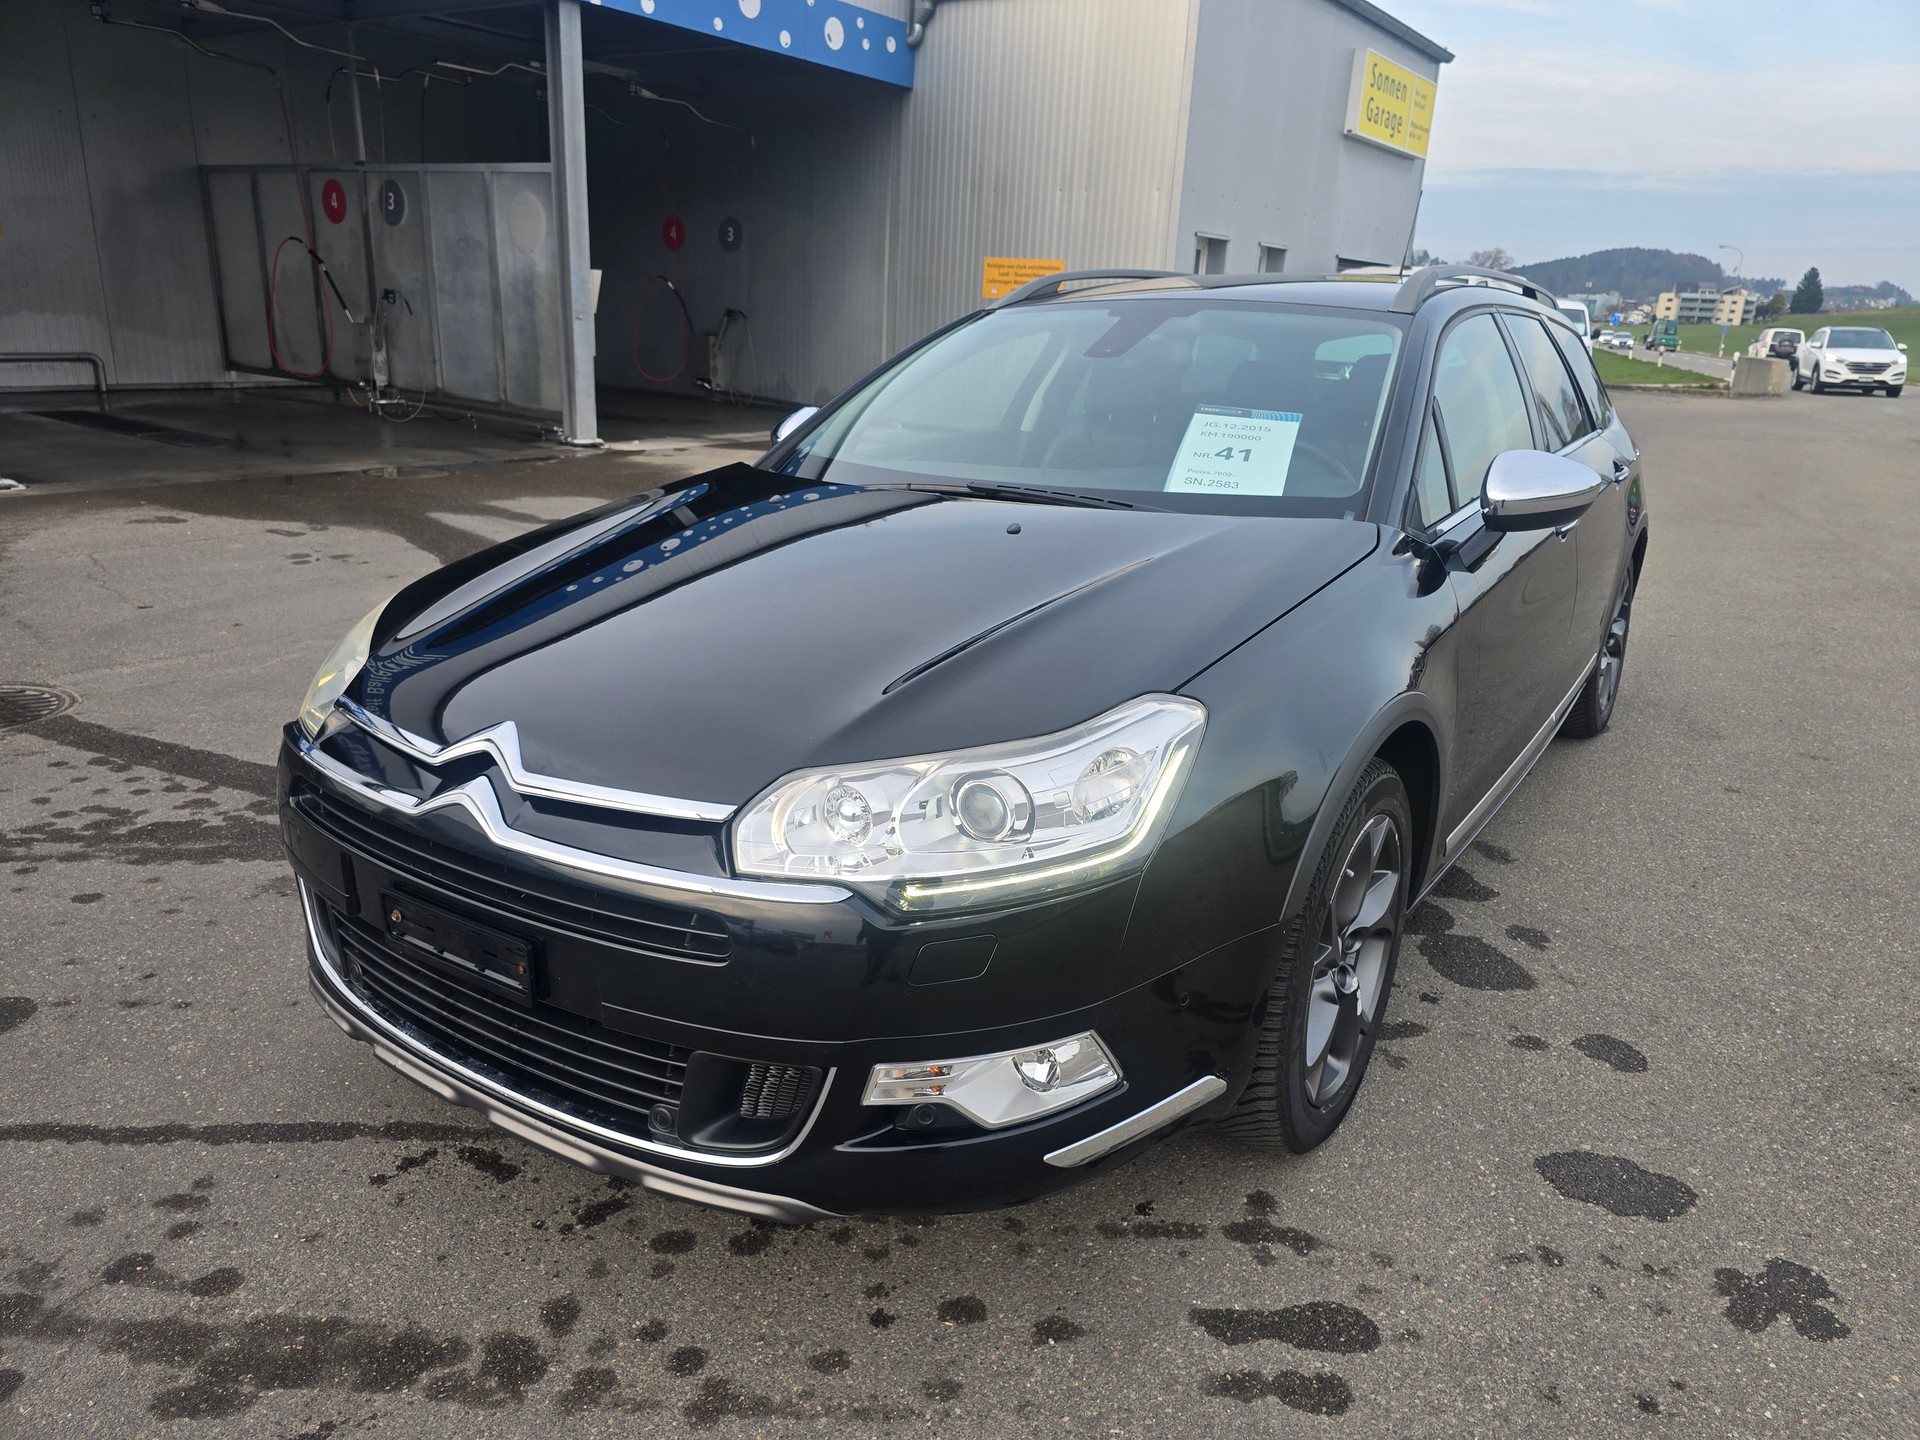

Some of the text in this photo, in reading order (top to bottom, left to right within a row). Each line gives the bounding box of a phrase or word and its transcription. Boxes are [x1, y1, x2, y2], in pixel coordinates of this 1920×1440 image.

[1371, 63, 1407, 102] Sonnen
[1367, 97, 1402, 137] Garage
[331, 192, 338, 209] 4
[388, 192, 394, 210] 3
[670, 225, 676, 240] 4
[728, 227, 733, 241] 3
[1184, 477, 1239, 489] SN.2583
